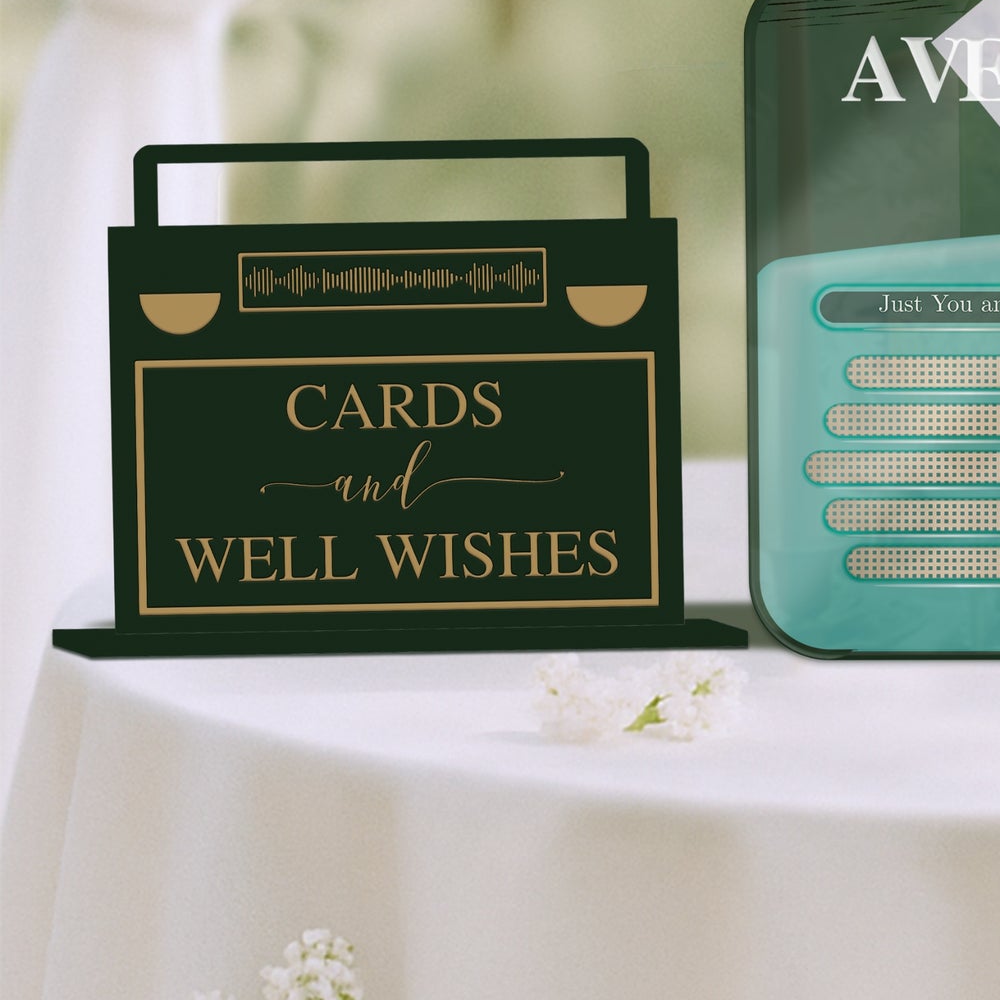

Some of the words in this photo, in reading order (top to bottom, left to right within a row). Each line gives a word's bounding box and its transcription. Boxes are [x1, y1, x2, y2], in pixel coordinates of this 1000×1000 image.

[878, 294, 922, 313] Just
[931, 294, 972, 313] You
[285, 381, 503, 431] CARDS
[174, 535, 359, 584] WELL
[376, 529, 619, 580] WISHES
